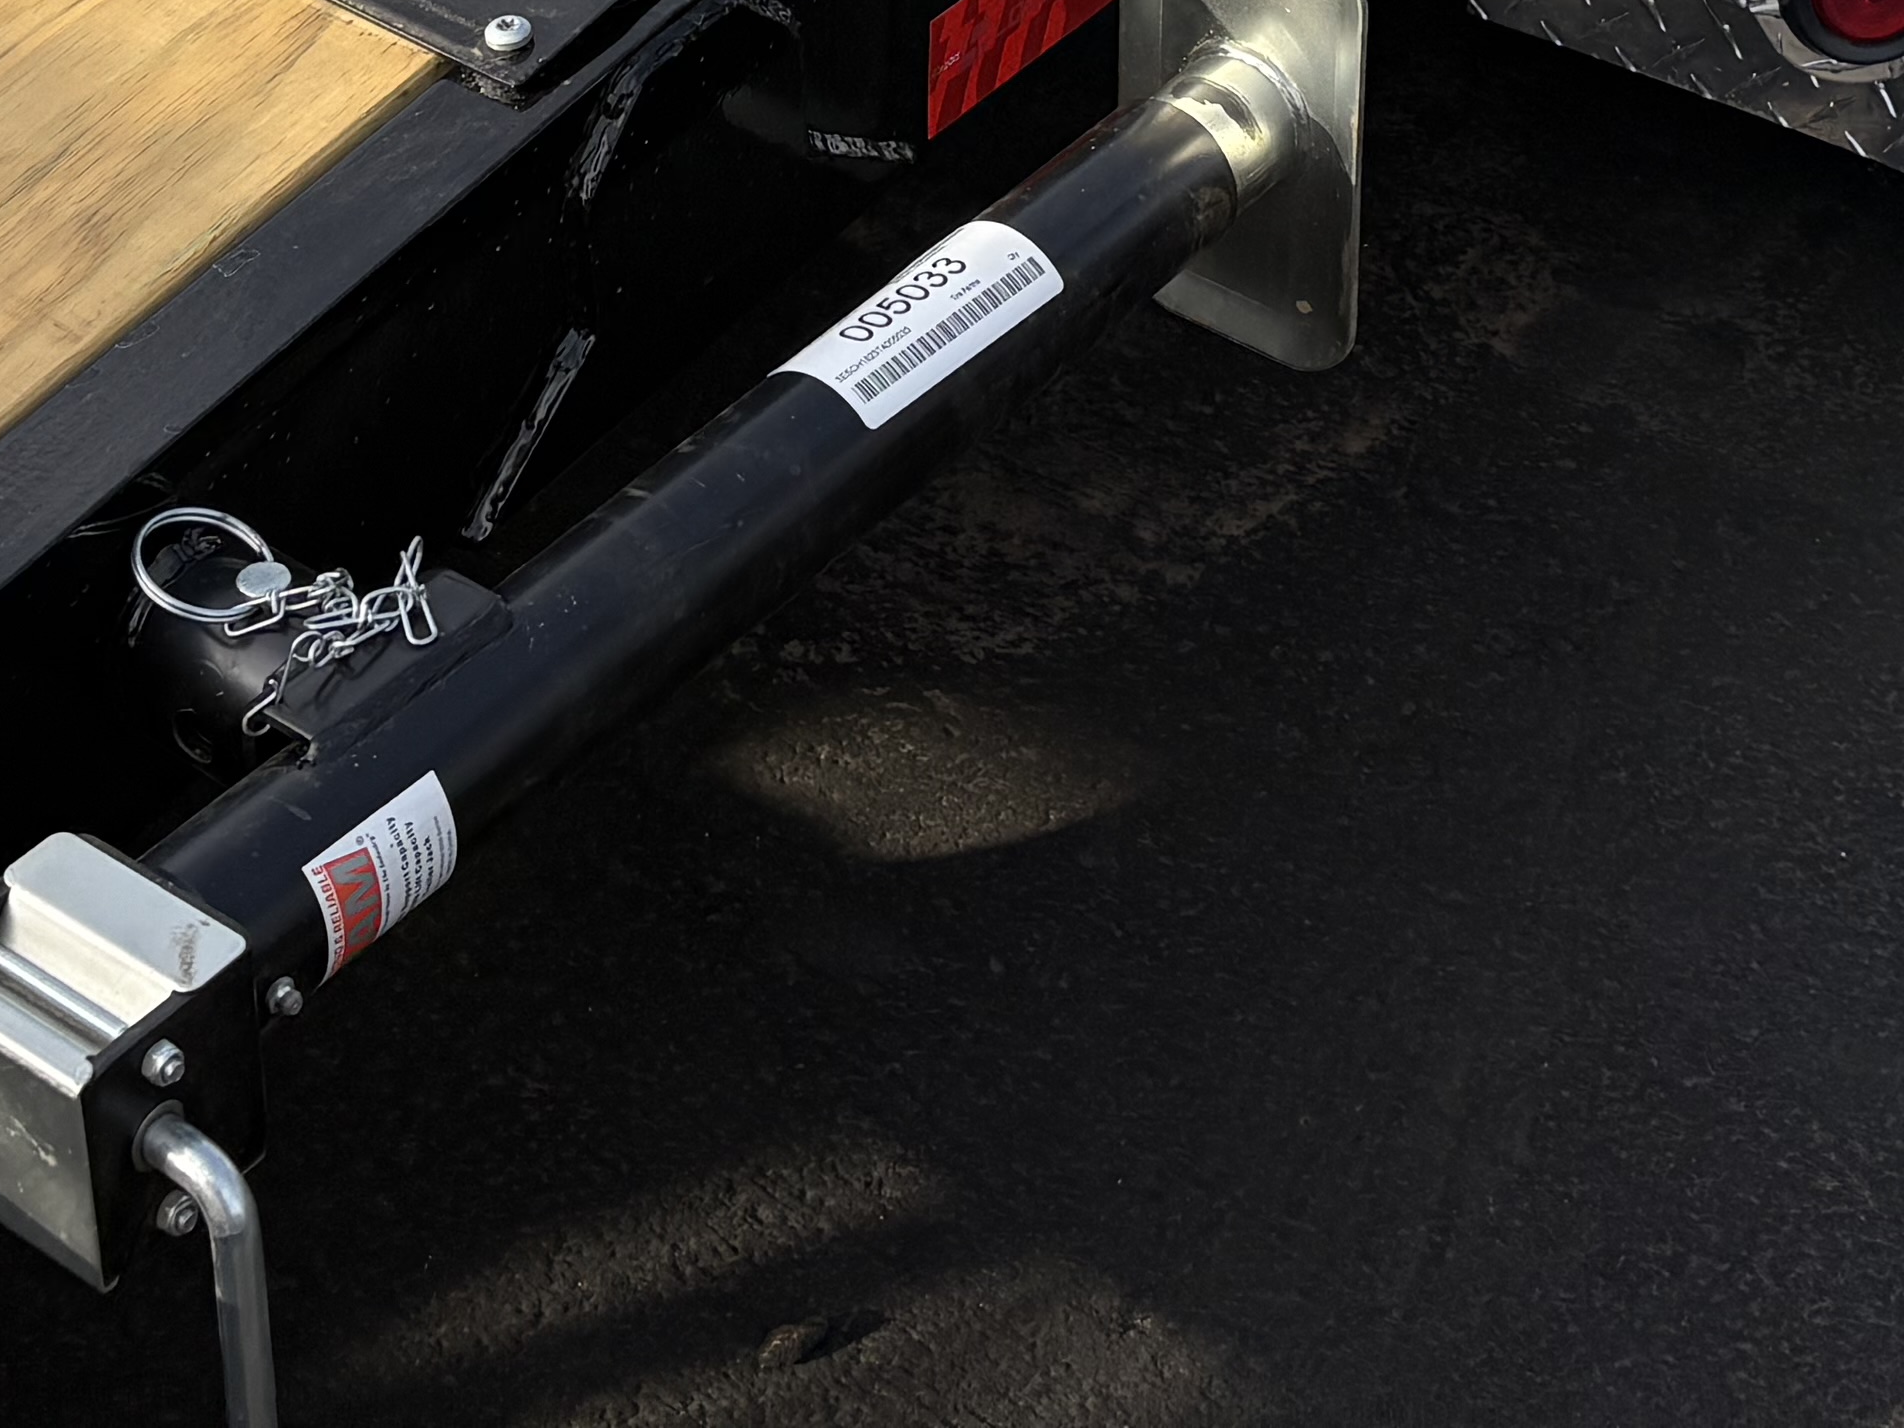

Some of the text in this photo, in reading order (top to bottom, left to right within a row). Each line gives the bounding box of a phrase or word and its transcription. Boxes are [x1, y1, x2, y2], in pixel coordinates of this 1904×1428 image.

[839, 256, 967, 343] 005033
[312, 864, 345, 934] RELIABLE
[330, 853, 381, 946] AM
